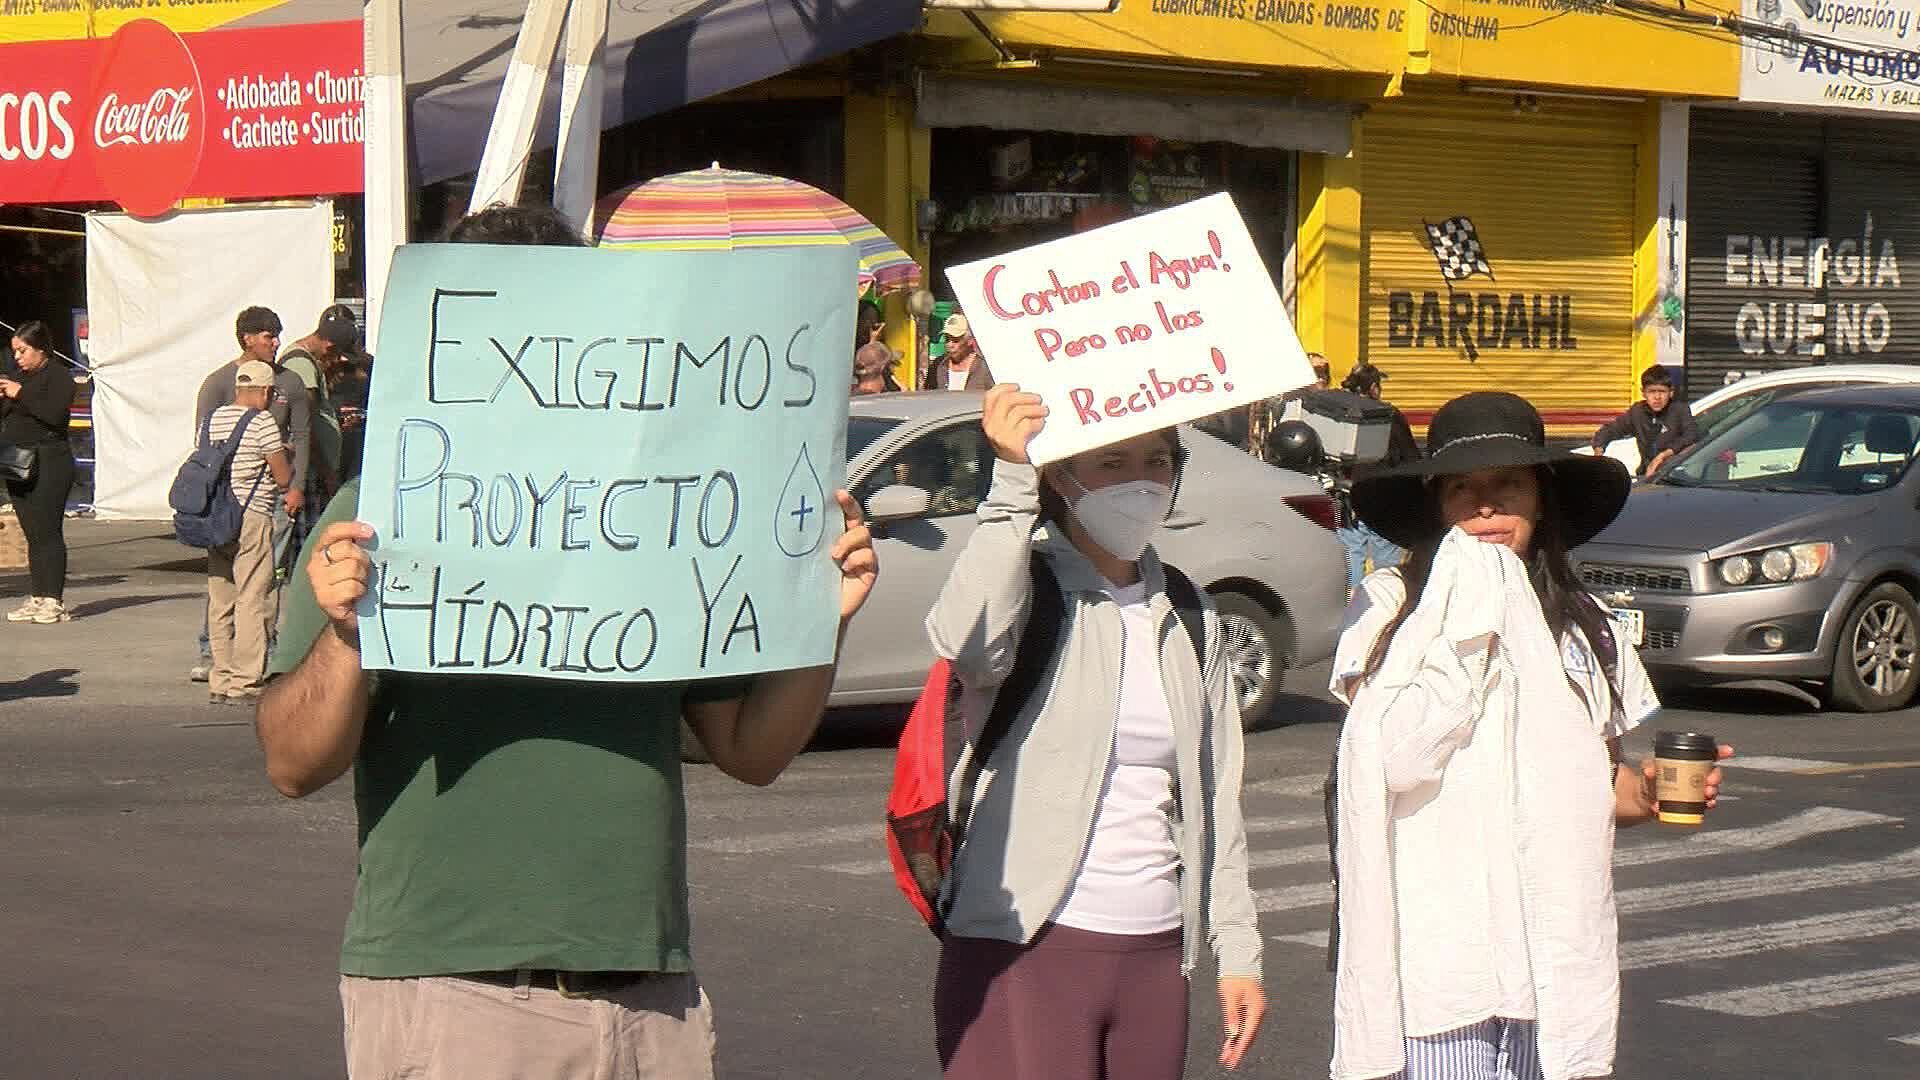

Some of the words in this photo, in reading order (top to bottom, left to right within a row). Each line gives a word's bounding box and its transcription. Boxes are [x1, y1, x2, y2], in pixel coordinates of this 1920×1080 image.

[1255, 2, 1314, 25] BANDAS
[1324, 7, 1380, 32] BOMBAS
[1387, 9, 1405, 32] DE
[1430, 12, 1499, 40] GASOLINA
[1897, 10, 1911, 38] y
[94, 86, 194, 149] Coca-Cola
[226, 71, 303, 110] Adobada
[1823, 84, 1874, 101] MAZAS
[1880, 88, 1890, 102] Y
[0, 90, 75, 160] COS
[231, 113, 300, 149] Cachete
[311, 107, 366, 145] Surtid
[982, 264, 1101, 321] Cortan
[1111, 260, 1140, 294] el
[1149, 229, 1231, 290] Agua!
[428, 288, 816, 412] EXIGIMOS
[1034, 327, 1107, 362] Pero
[1115, 323, 1152, 345] no
[1388, 290, 1577, 364] BARDAHL
[1735, 302, 1826, 357] QUE
[1835, 302, 1892, 354] NO
[1069, 346, 1235, 426] Recibos!
[391, 417, 739, 552] PROYECTO
[378, 560, 659, 674] HÍDRICO
[691, 553, 762, 668] YA
